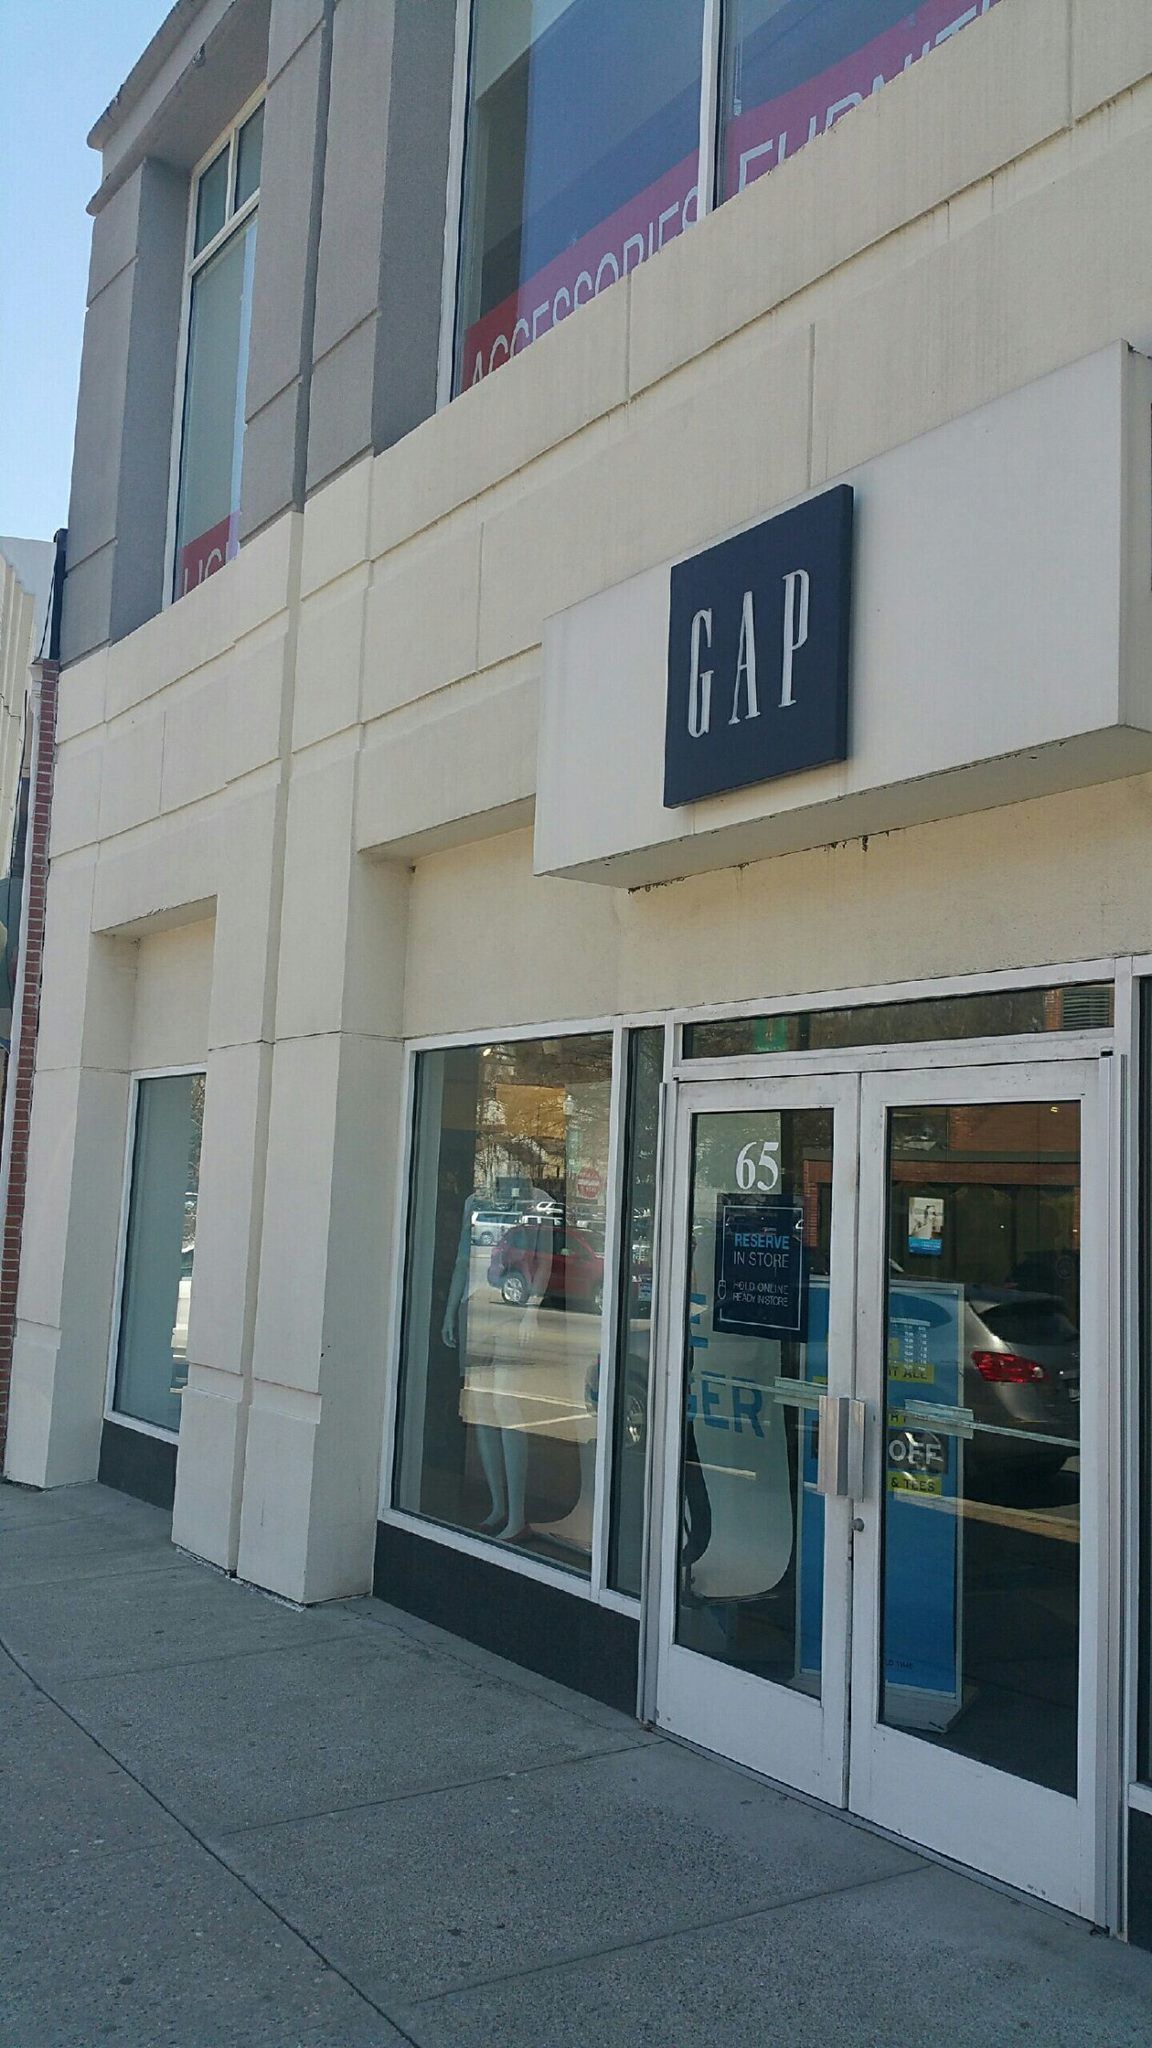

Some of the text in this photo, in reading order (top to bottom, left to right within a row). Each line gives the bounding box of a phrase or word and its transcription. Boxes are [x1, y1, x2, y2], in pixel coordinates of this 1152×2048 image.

[688, 568, 809, 738] GAP
[736, 1141, 779, 1191] 65
[734, 1232, 790, 1250] RESERVE
[733, 1250, 790, 1269] IN STORE
[733, 1280, 789, 1295] HOLD ONLINE
[732, 1292, 756, 1303] READY
[765, 1295, 789, 1307] STORE
[888, 1439, 942, 1465] OFF
[904, 1478, 935, 1491] TEES
